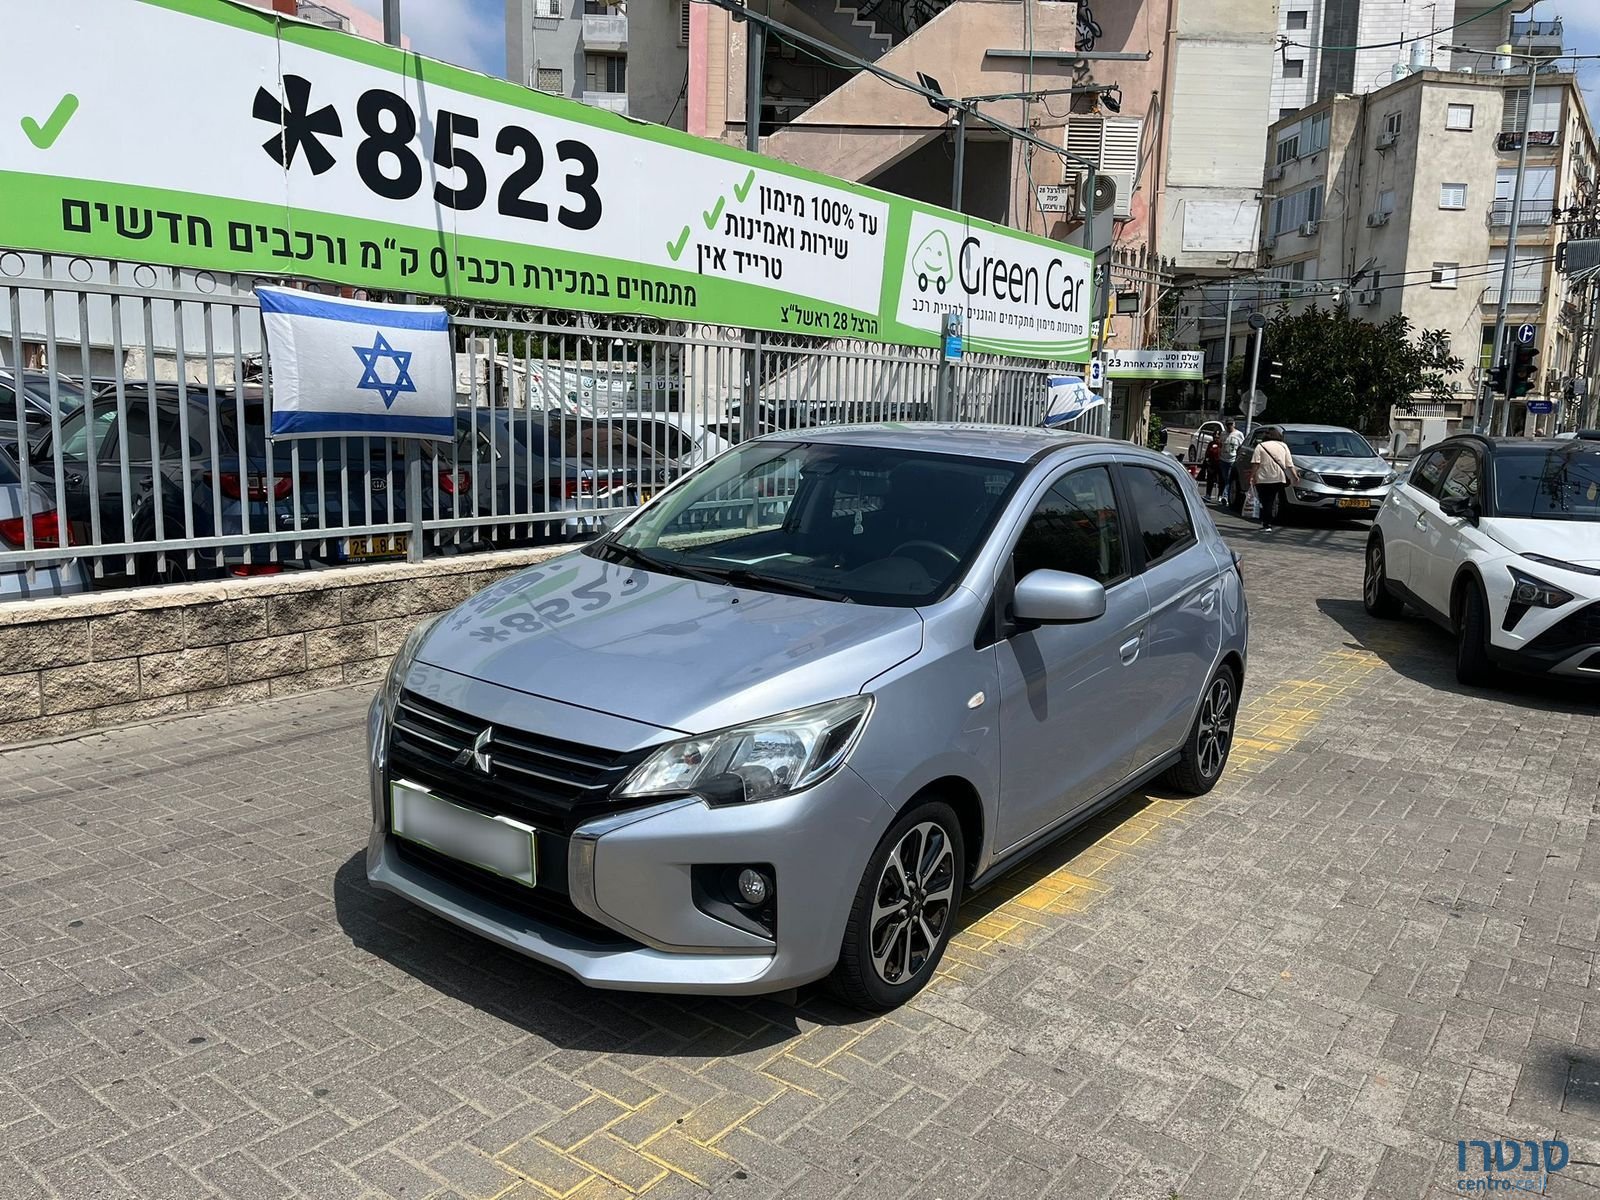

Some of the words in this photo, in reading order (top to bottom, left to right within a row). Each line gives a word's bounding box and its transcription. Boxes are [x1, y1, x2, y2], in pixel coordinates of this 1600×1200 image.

[759, 185, 805, 218] מימון
[811, 196, 854, 230] 100%
[62, 198, 213, 249] חדשים
[725, 213, 794, 249] ואמינות
[858, 212, 878, 236] עד
[228, 221, 347, 266] ורכבים
[360, 237, 419, 276] ק"מ
[697, 243, 727, 274] אין
[799, 230, 848, 260] שירות
[430, 246, 447, 278] 0
[456, 255, 515, 287] רכבי
[732, 250, 782, 279] טרייד
[958, 236, 1039, 306] Green
[1045, 258, 1084, 313] Car
[523, 264, 610, 297] במכירת
[616, 276, 697, 307] מתמחים
[912, 298, 930, 313] רכב
[833, 311, 848, 331] 28
[850, 312, 878, 335] הרצל
[999, 312, 1034, 330] מתקדמים
[1036, 317, 1055, 332] מימון
[1057, 320, 1083, 335] פתרונות
[1108, 358, 1121, 368] 23
[1146, 361, 1164, 370] קצת
[1176, 361, 1199, 369] אצלנו
